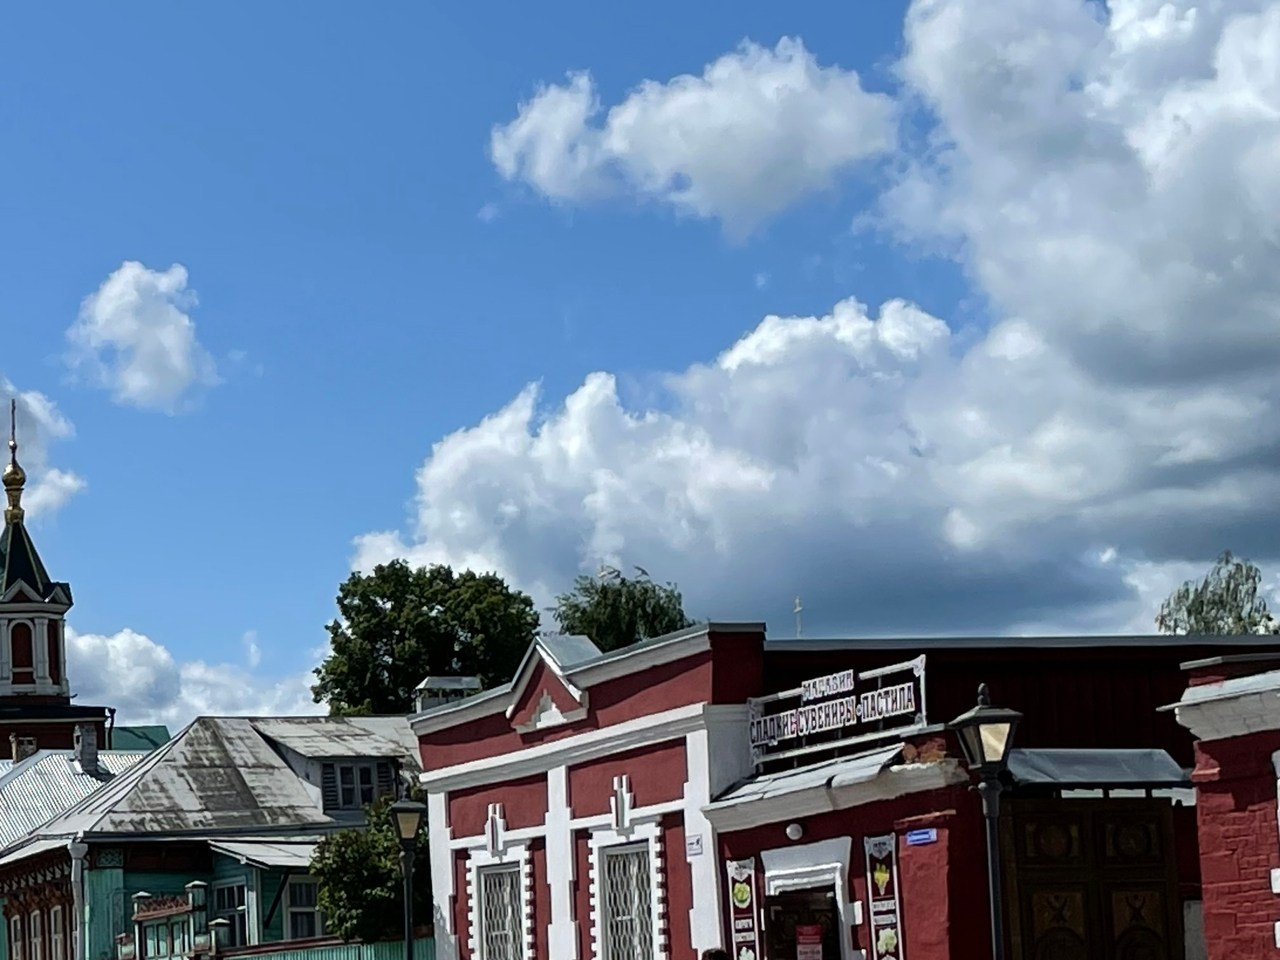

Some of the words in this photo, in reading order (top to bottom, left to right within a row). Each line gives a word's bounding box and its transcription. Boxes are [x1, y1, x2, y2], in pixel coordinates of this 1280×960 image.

[802, 671, 854, 700] МАГАЗИН
[750, 710, 797, 745] СЛАДКИЕ
[798, 697, 857, 734] СУВЕНИРЫ
[862, 684, 914, 720] ПАСТИЛА
